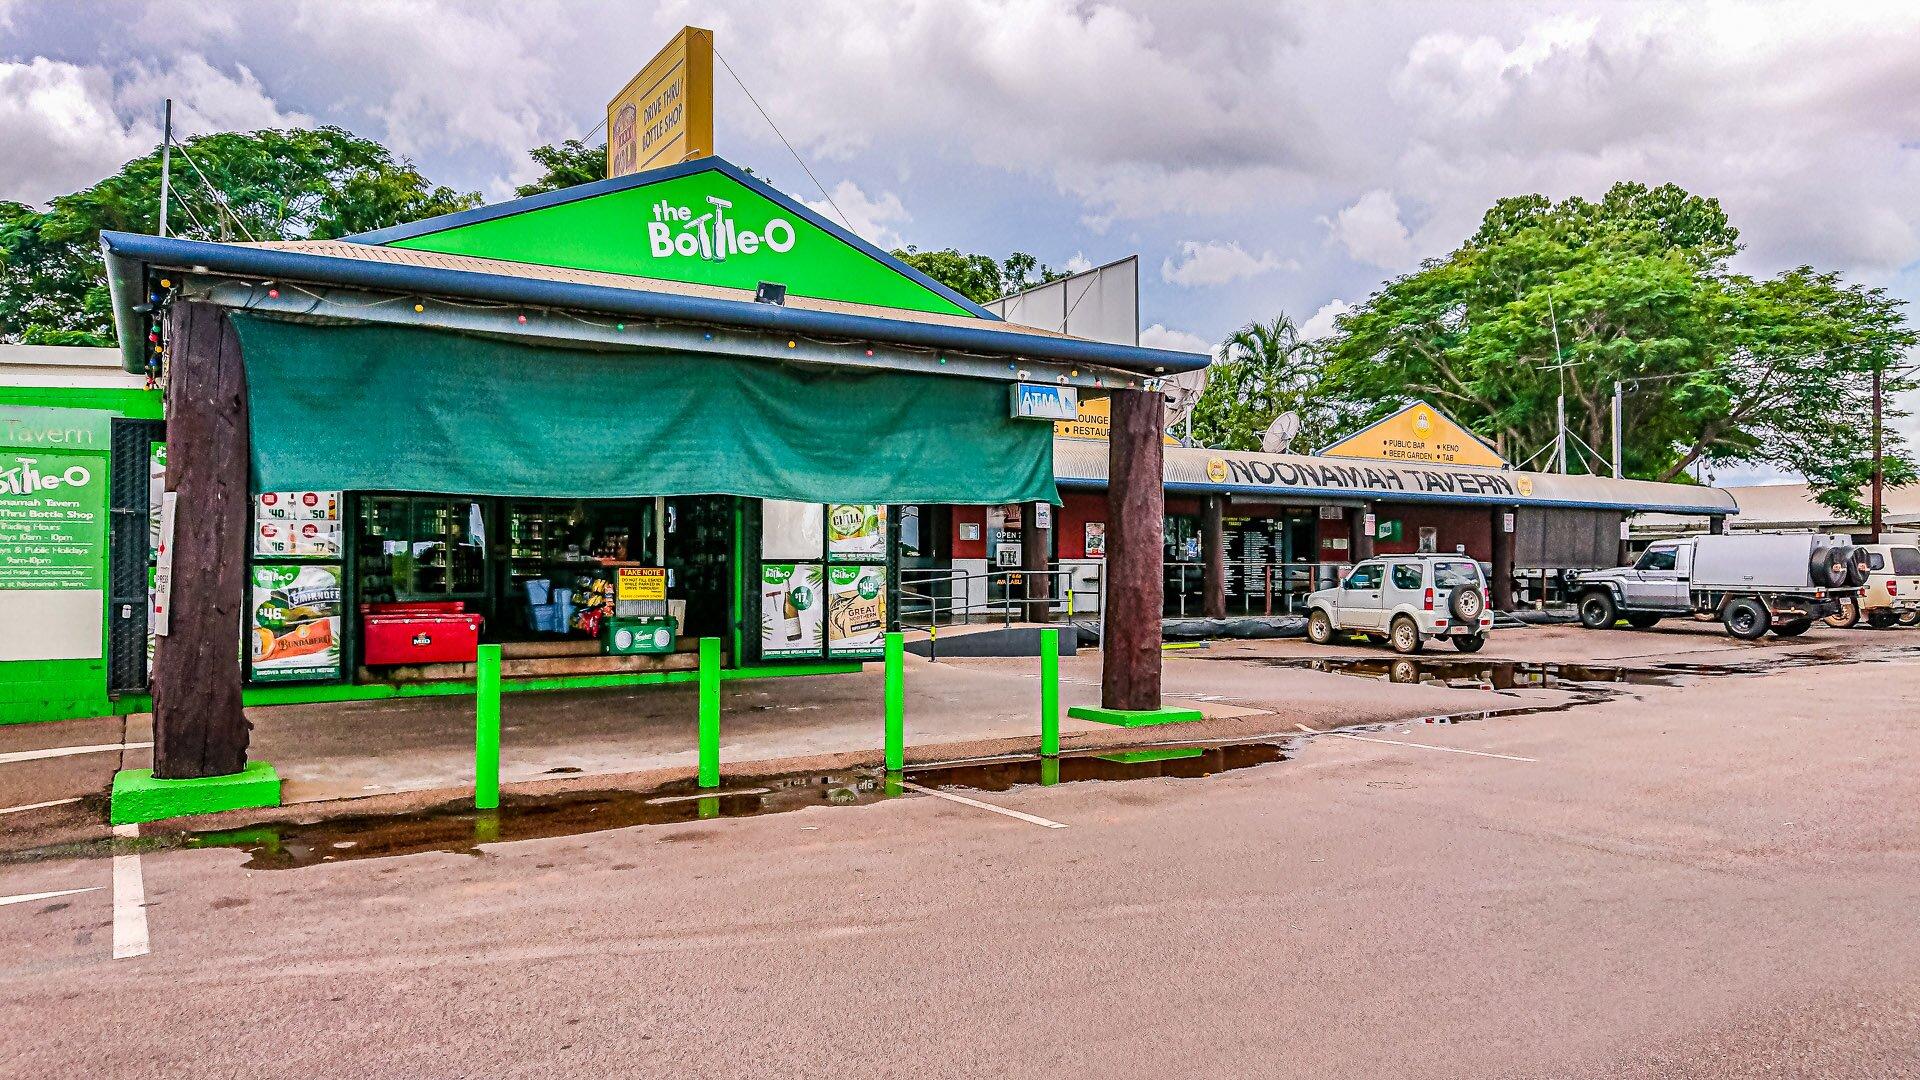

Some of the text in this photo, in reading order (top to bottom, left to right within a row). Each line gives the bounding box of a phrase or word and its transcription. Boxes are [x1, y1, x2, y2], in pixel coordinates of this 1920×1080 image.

[644, 95, 662, 126] DRIVE
[643, 102, 683, 152] BOTTLE SHOP
[653, 200, 692, 221] the
[1021, 391, 1055, 414] ATM
[1076, 415, 1108, 425] OUNGE
[8, 420, 92, 444] Tavern
[1389, 440, 1425, 449] PUBLIC BAR
[1443, 444, 1459, 452] KENO
[1389, 450, 1433, 460] BEER GARDEN
[1225, 459, 1404, 490] NOONAMAH
[1402, 469, 1514, 495] TAVERN
[29, 510, 63, 518] Bottle
[67, 511, 94, 520] Shop
[269, 509, 284, 518] $40
[310, 509, 325, 519] $50
[996, 531, 1017, 539] OPEN
[53, 547, 88, 556] Holidays
[849, 605, 876, 616] GREAT
